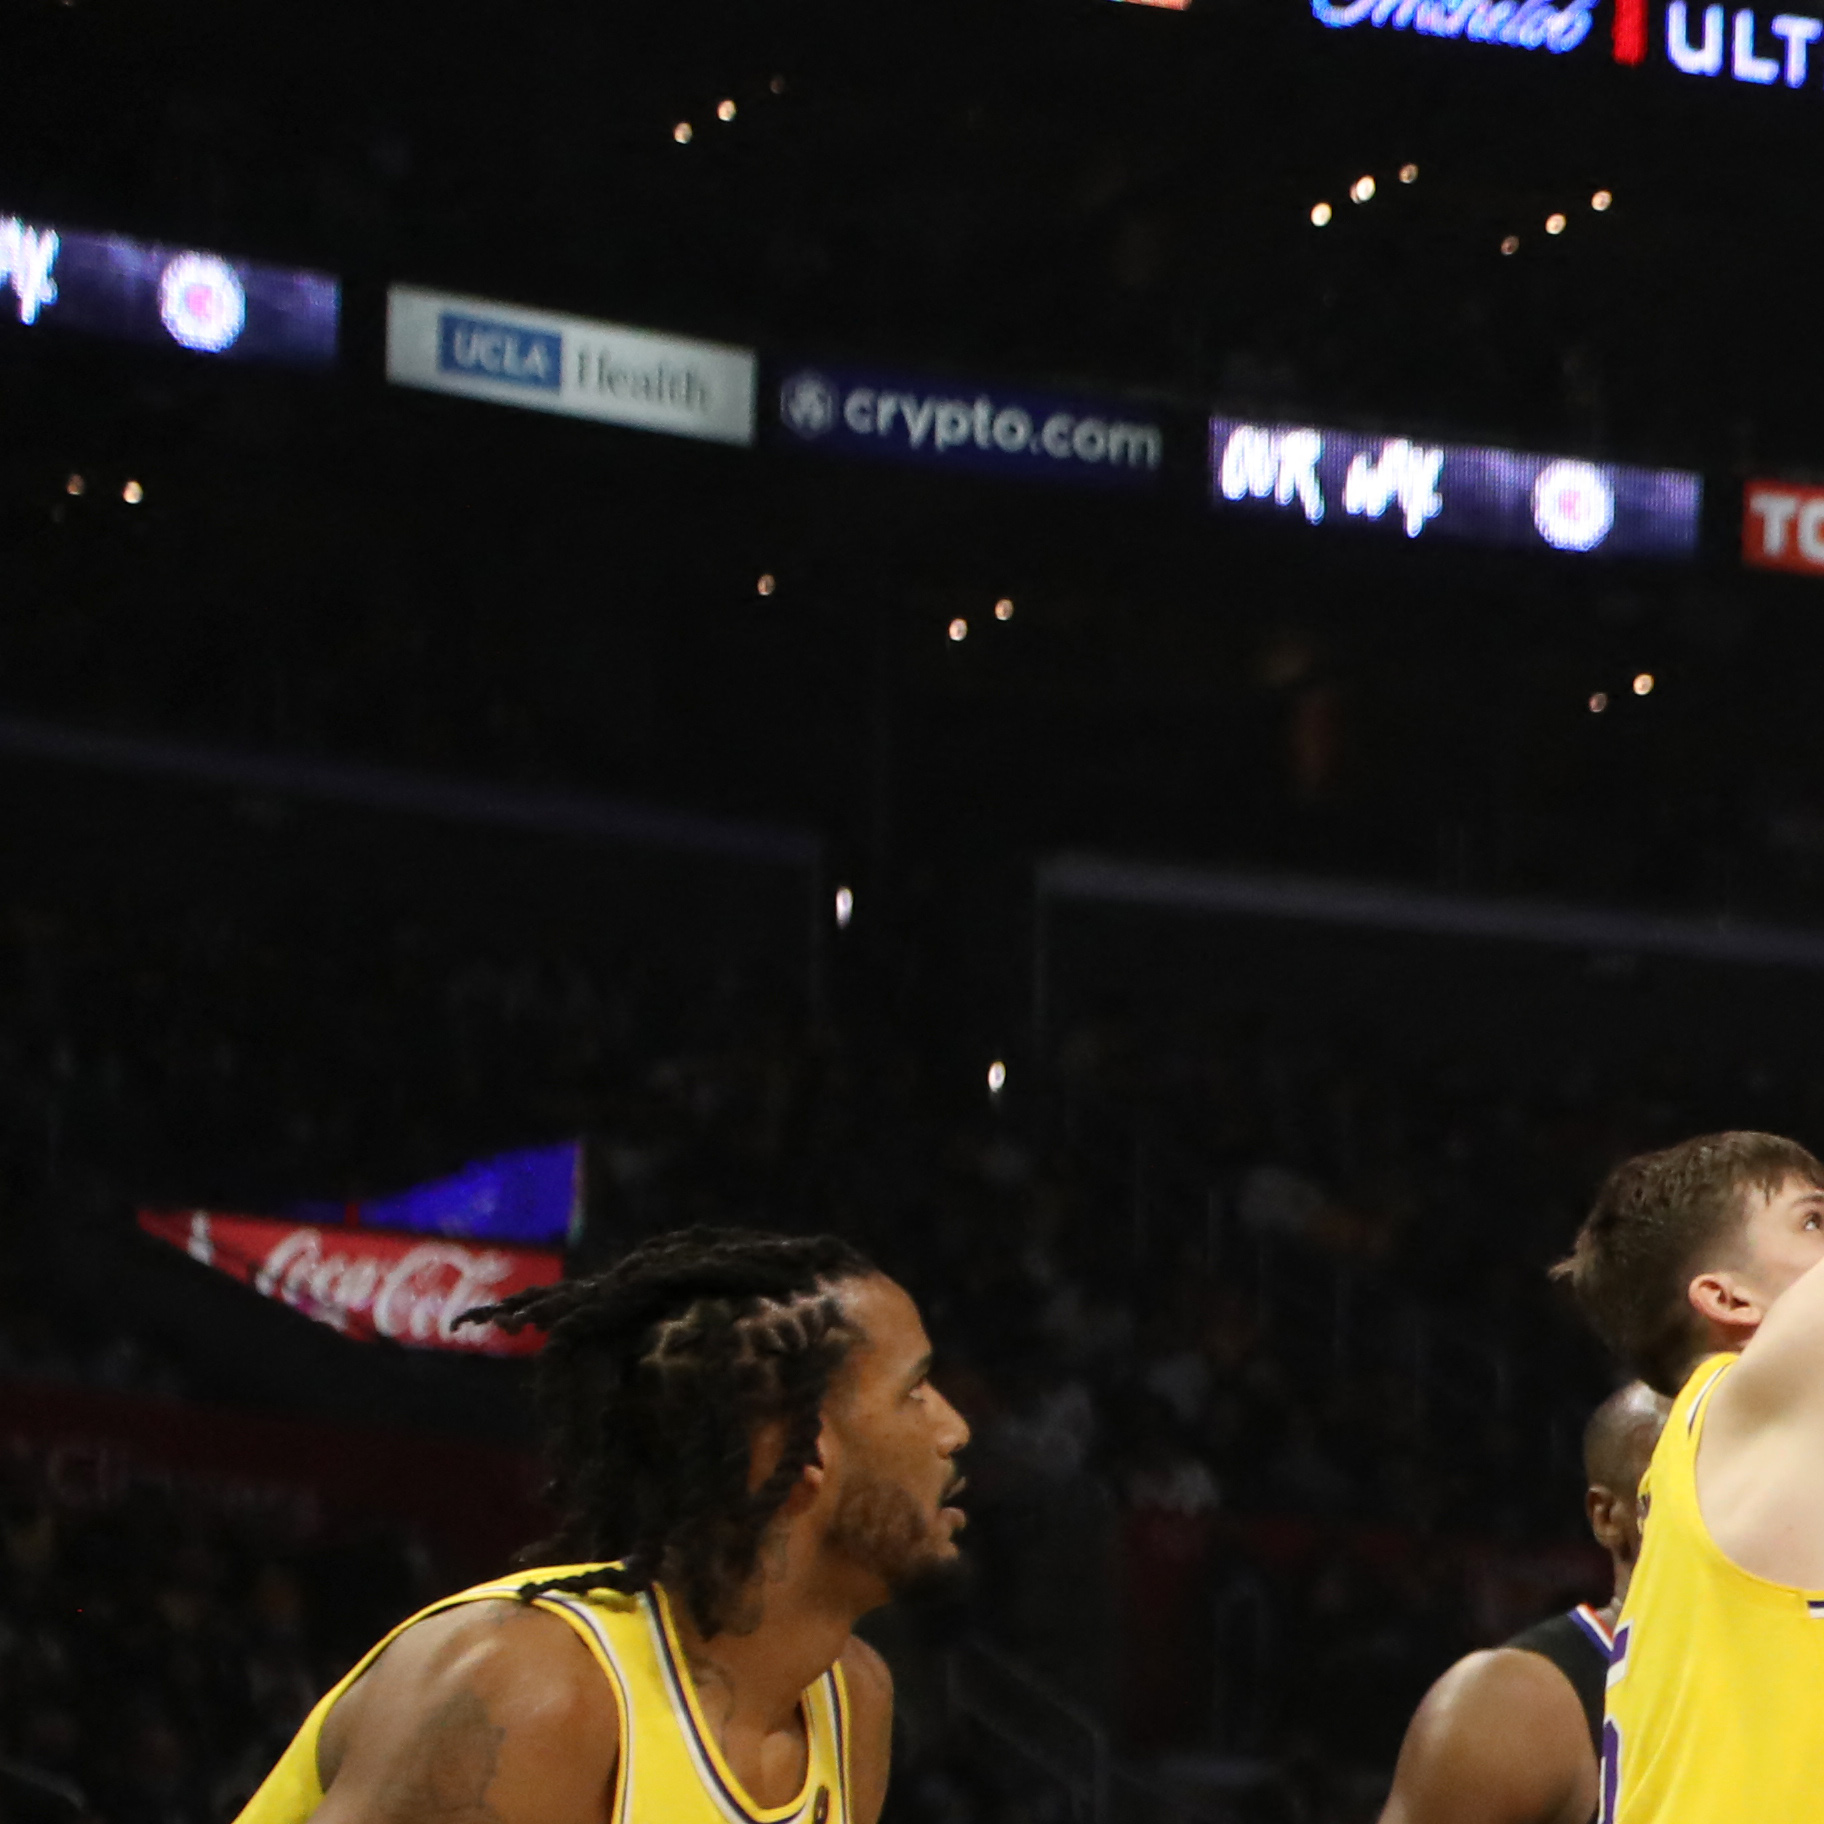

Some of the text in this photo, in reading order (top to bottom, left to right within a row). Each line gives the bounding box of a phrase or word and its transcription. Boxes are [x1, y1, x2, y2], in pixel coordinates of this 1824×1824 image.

[452, 323, 713, 415] UCLA Health
[843, 386, 1163, 471] crypto.com
